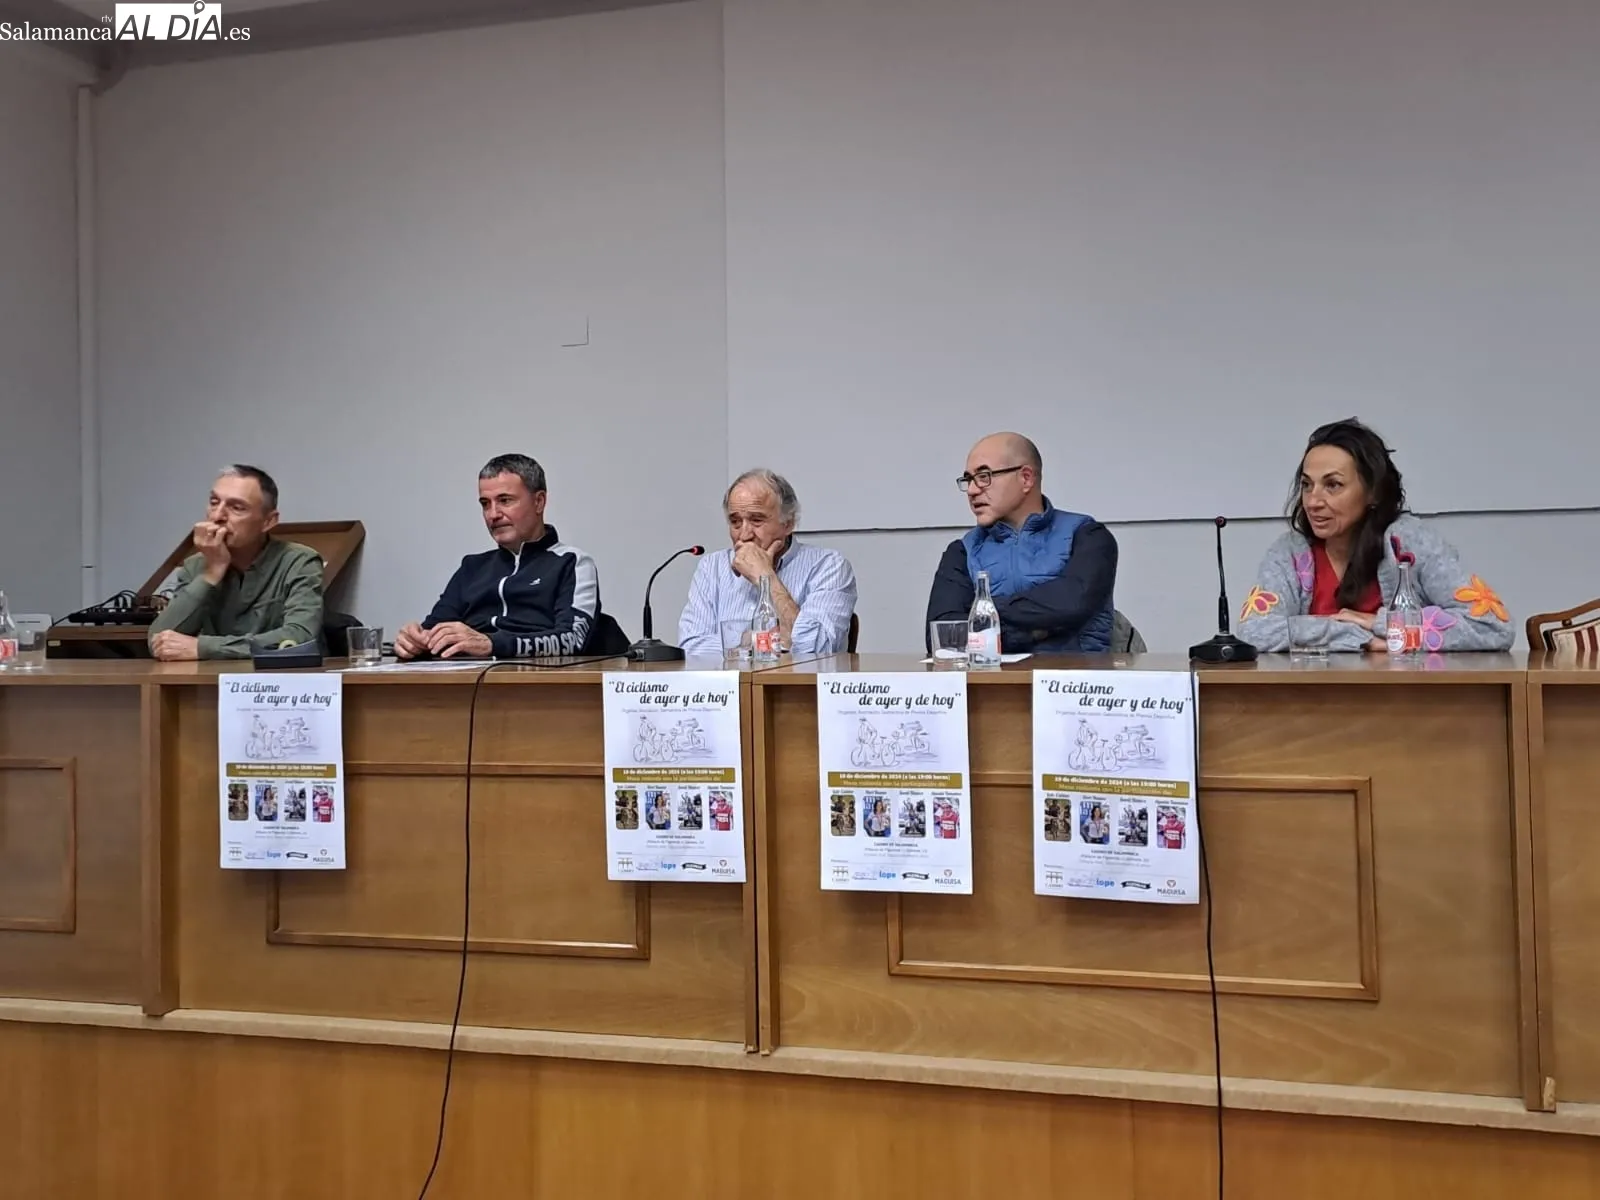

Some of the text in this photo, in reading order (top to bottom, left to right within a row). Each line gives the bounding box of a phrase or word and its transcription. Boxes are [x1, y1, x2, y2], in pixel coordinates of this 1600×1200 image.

[626, 681, 669, 693] ciclismo
[843, 682, 890, 694] ciclismo
[1062, 681, 1114, 695] ciclismo
[639, 693, 652, 704] de
[654, 695, 680, 707] ayer
[683, 695, 689, 707] y
[692, 692, 704, 704] de
[858, 695, 871, 706] de
[875, 697, 902, 709] ayer
[905, 697, 912, 709] y
[915, 694, 929, 706] de
[1079, 694, 1093, 706] de
[1097, 698, 1127, 711] ayer
[1130, 699, 1138, 712] y
[1141, 697, 1157, 709] de
